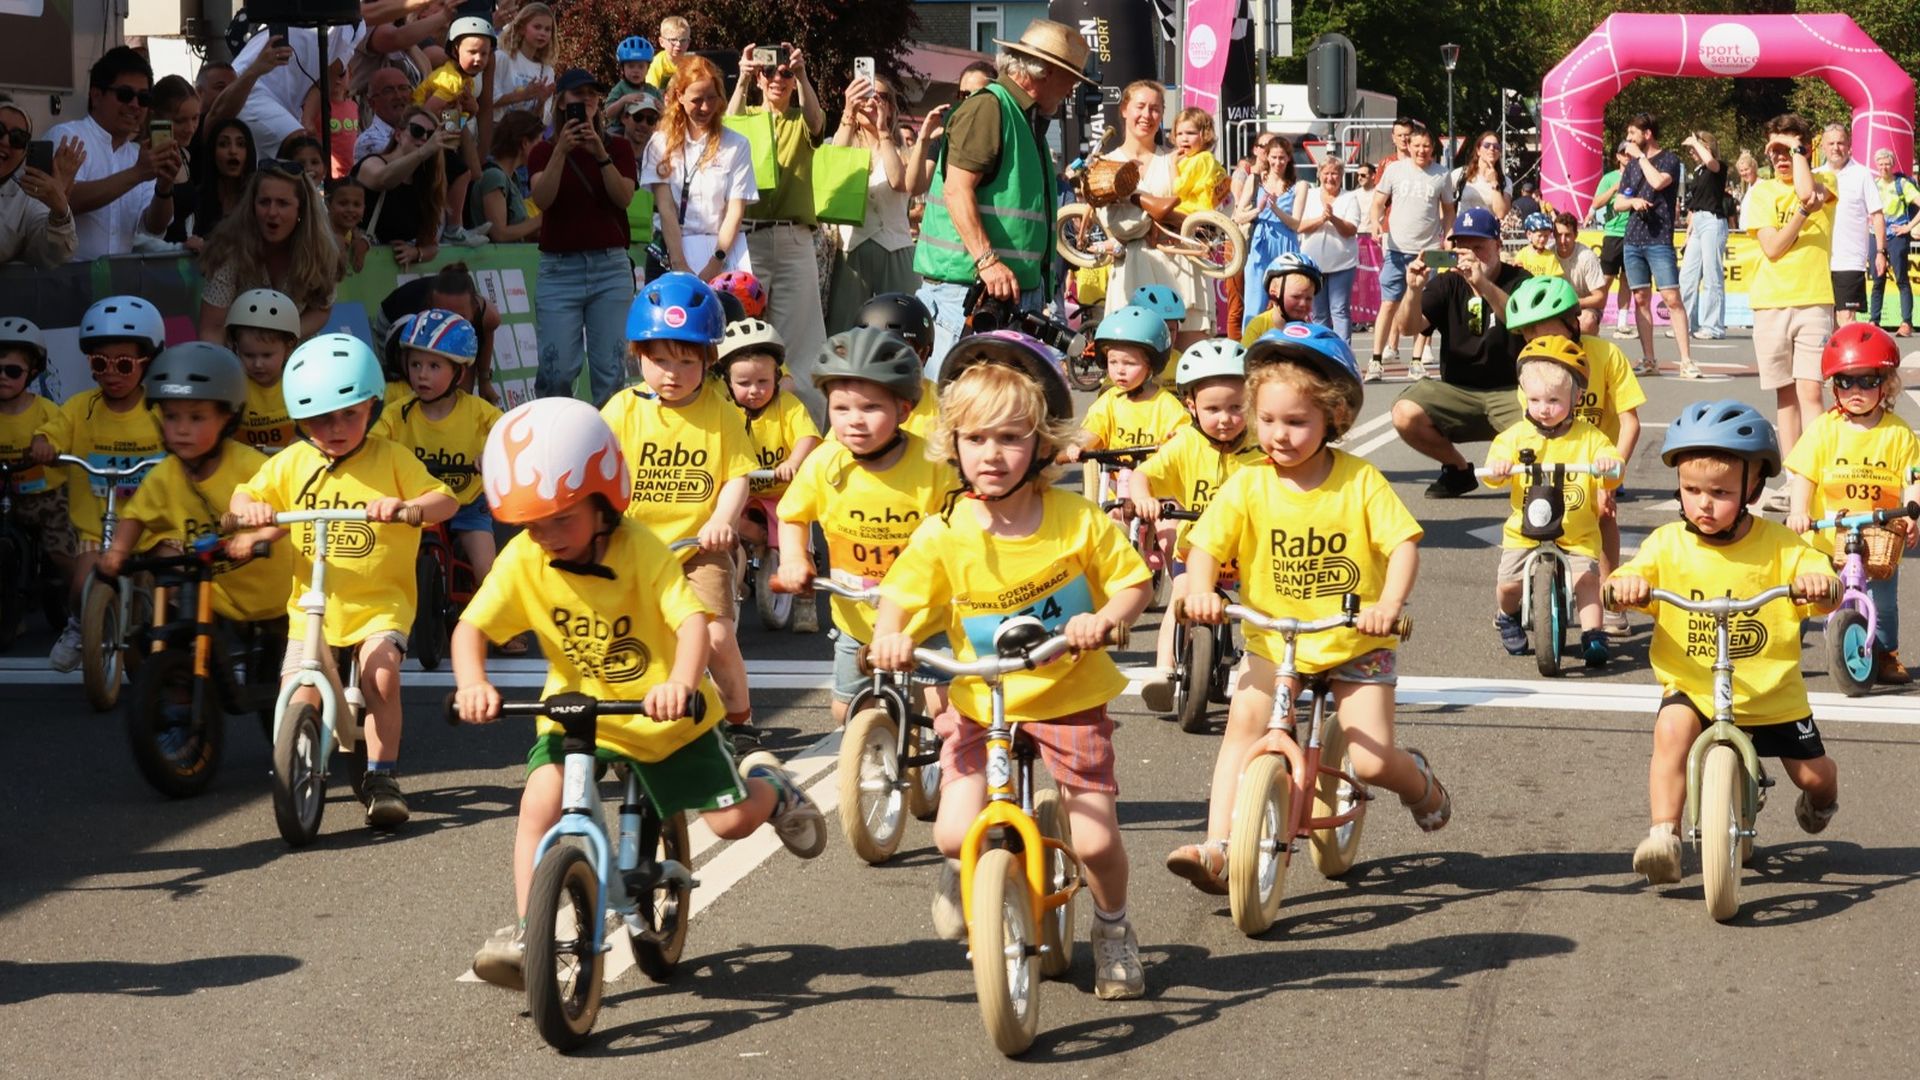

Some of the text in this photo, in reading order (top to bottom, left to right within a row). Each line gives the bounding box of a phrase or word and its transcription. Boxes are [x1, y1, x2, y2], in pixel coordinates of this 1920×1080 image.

[1097, 17, 1111, 62] SPORT
[1699, 44, 1741, 57] sport
[1711, 55, 1760, 64] service
[247, 428, 282, 444] 008
[639, 442, 708, 467] Rabo
[637, 469, 682, 479] DIKKE
[634, 481, 699, 491] BANDEN
[1193, 479, 1221, 501] Ra
[1846, 484, 1881, 501] 033
[632, 492, 673, 502] RACE
[860, 526, 890, 534] COENS
[1271, 527, 1347, 558] Rabo
[853, 543, 900, 565] 011
[863, 567, 890, 578] Jos
[1273, 558, 1320, 572] DIKKE
[1273, 570, 1340, 587] BANDEN
[971, 570, 1070, 610] DIKKE BANDENRACE
[998, 581, 1036, 602] COENS
[1275, 584, 1312, 600] RACE
[553, 606, 632, 641] Rabo
[1688, 632, 1752, 646] BANEN
[1686, 646, 1716, 658] RAC
